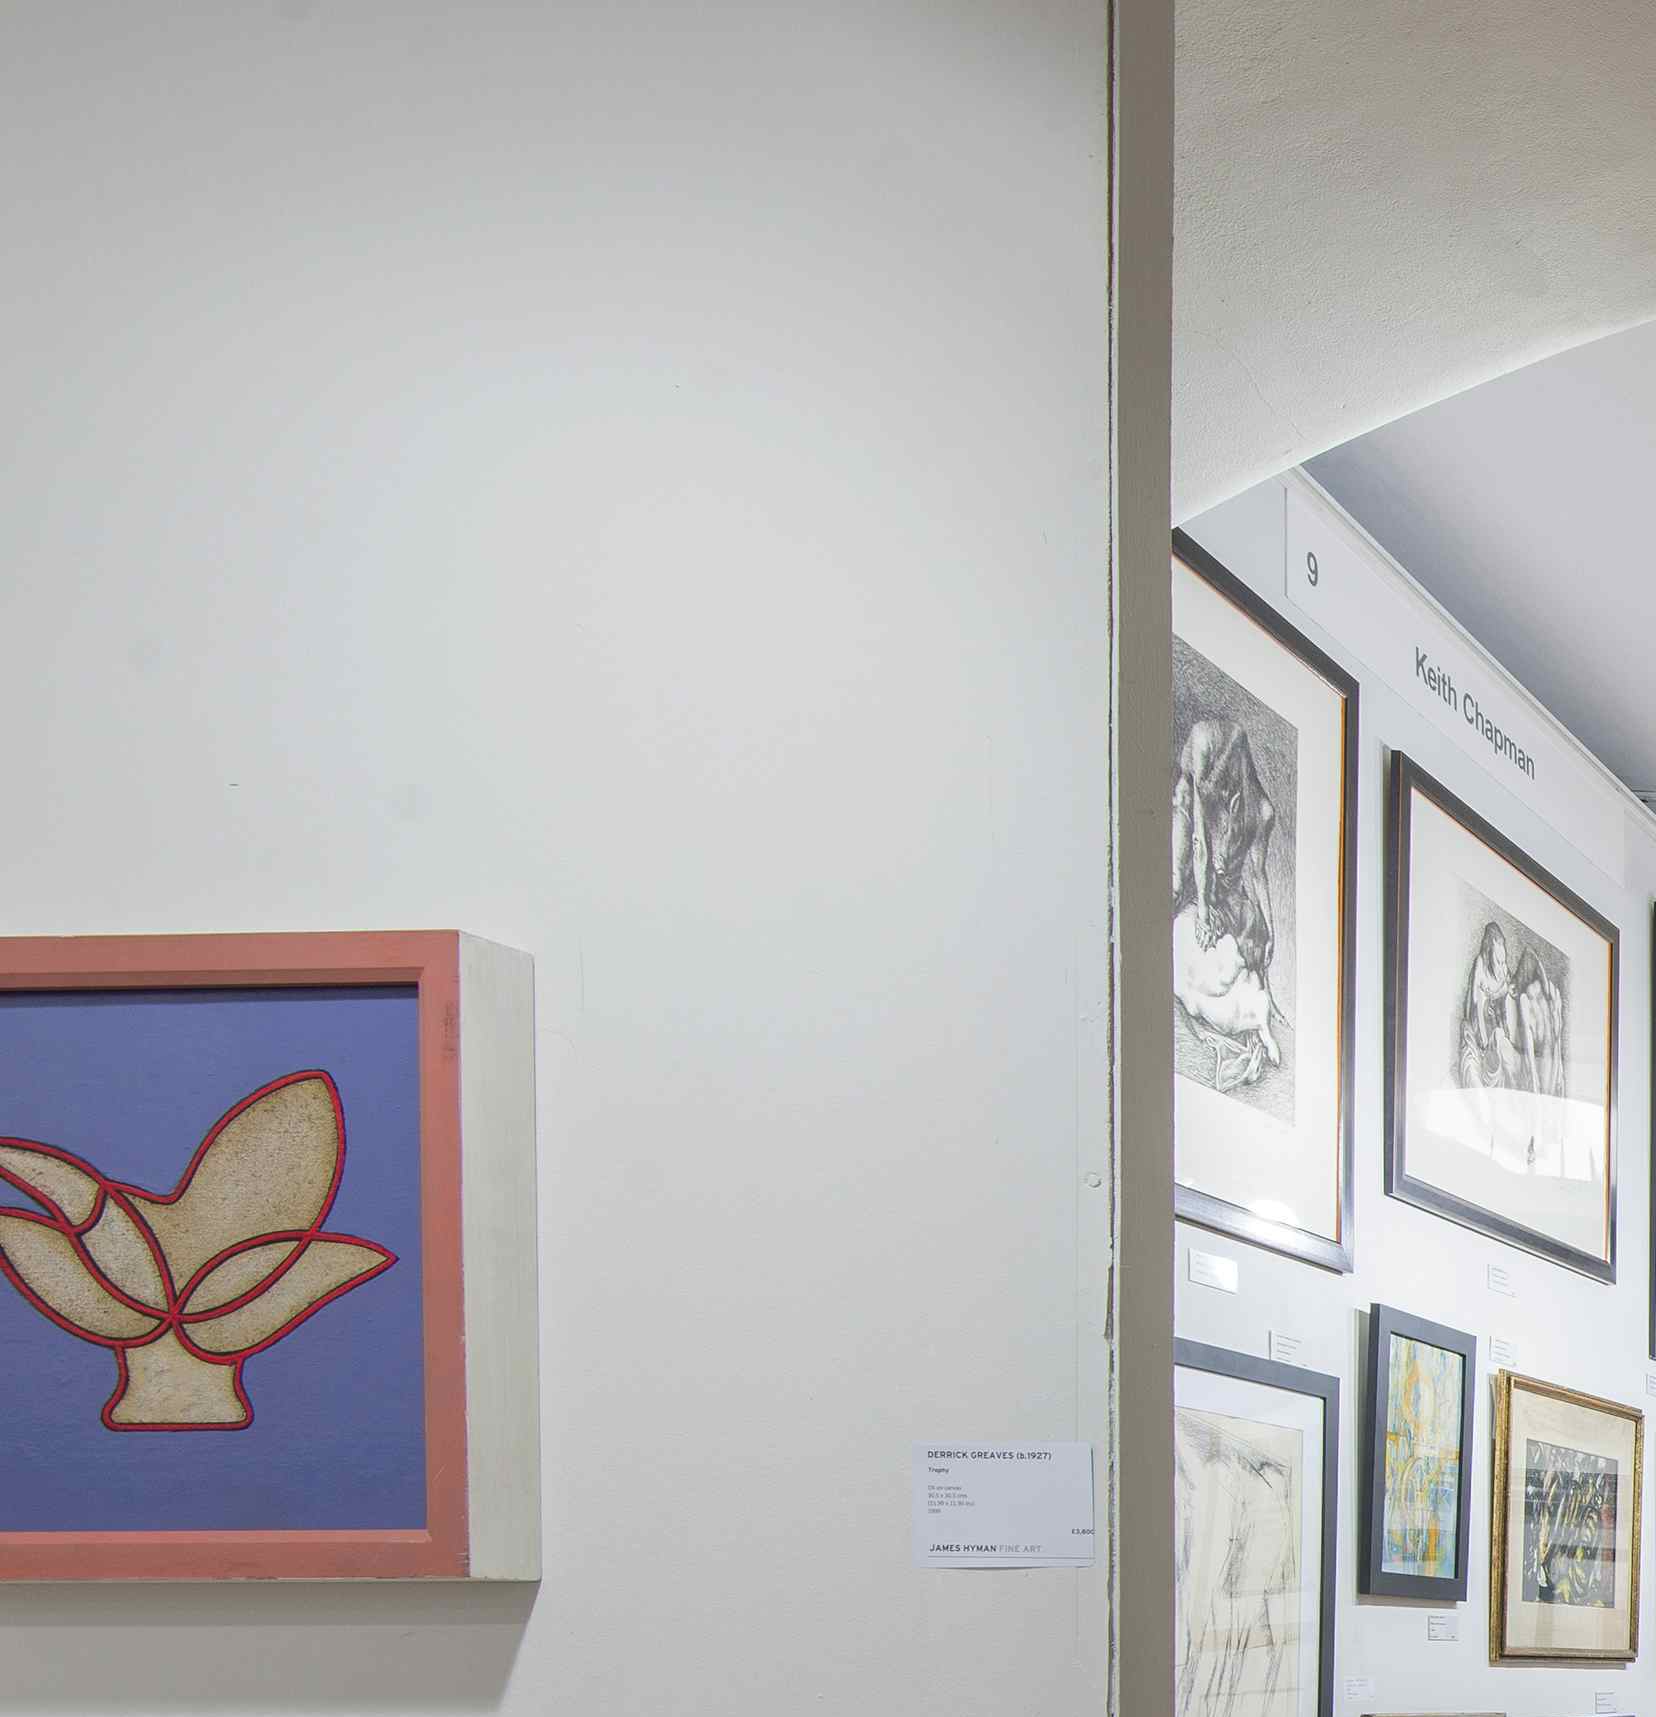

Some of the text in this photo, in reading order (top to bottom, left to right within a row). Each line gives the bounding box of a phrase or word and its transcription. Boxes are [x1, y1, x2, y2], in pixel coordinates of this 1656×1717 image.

[1306, 551, 1319, 587] 9
[1415, 646, 1536, 781] Keith Chapman
[927, 1450, 968, 1459] DERRICK
[970, 1451, 1014, 1460] GREAVES
[929, 1544, 1043, 1553] JAMES HYMAN FINE ART
